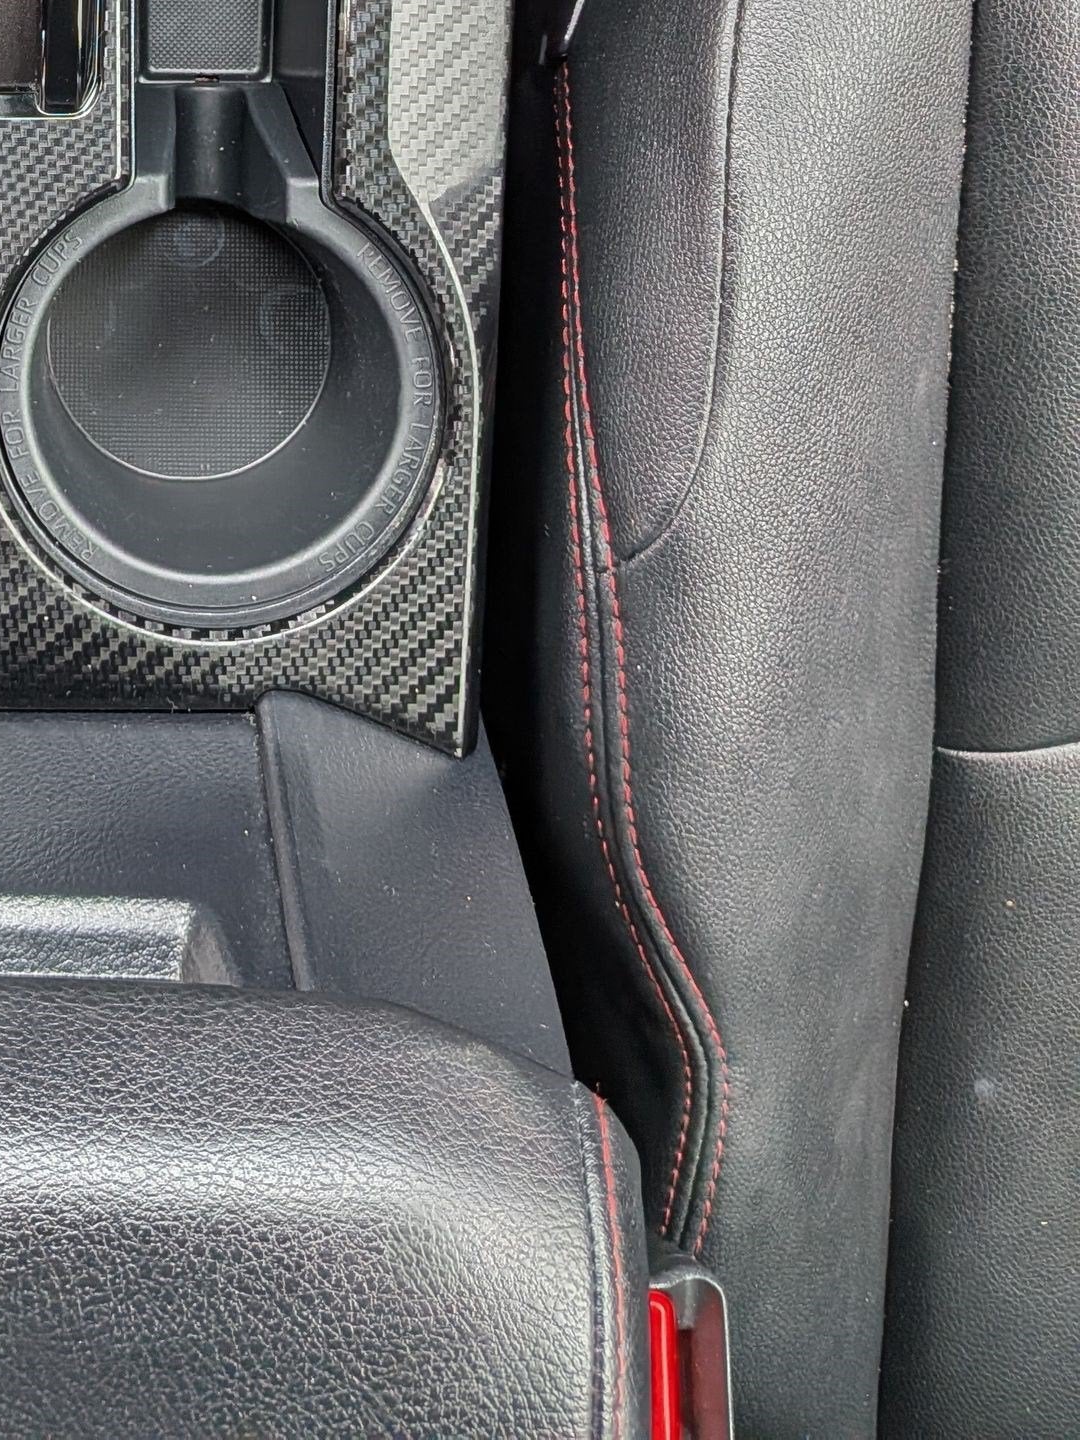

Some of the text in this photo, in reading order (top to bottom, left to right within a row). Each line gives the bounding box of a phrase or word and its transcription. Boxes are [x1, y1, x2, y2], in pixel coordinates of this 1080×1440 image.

[30, 230, 85, 290] CUPS
[4, 409, 30, 460] FOR
[317, 243, 434, 574] REMOVE FOR LARGER CUPS
[22, 471, 100, 563] REMOVE
